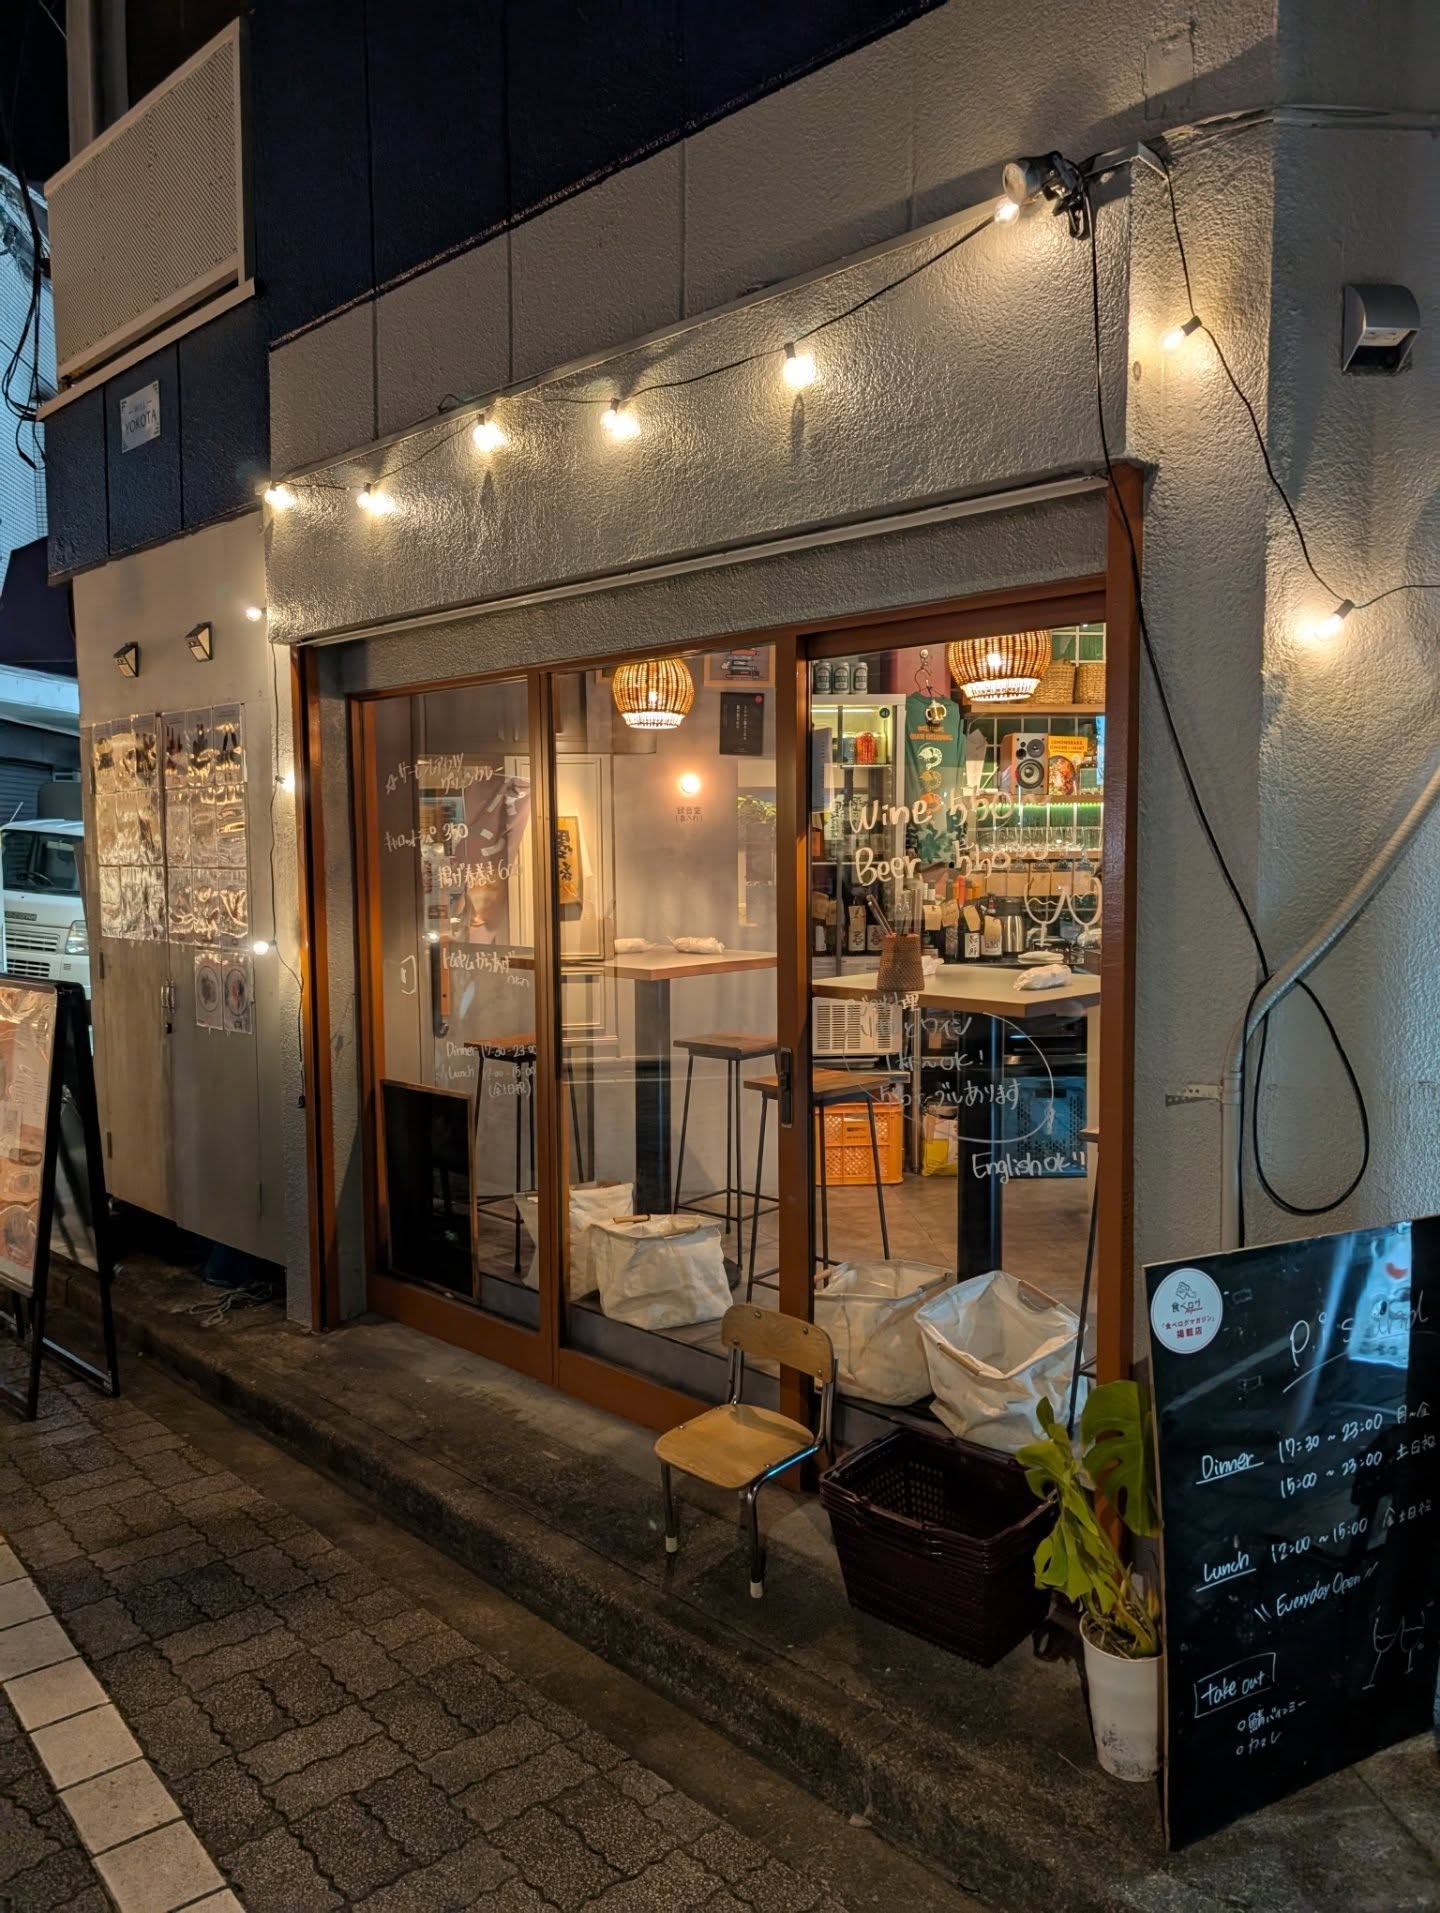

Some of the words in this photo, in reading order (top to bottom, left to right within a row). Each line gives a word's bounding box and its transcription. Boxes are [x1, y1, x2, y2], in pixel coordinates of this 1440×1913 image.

[125, 408, 158, 435] YOKOTA
[850, 799, 933, 834] Wine
[855, 847, 922, 887] Beer
[446, 1041, 478, 1057] Dinner
[448, 1064, 474, 1080] Lunch
[971, 1152, 1042, 1184] English
[1171, 1298, 1202, 1313] 食べログ
[1176, 1326, 1203, 1339] 掲載店
[1201, 1452, 1254, 1480] Dinner
[1278, 1435, 1320, 1463] 17:30
[1341, 1413, 1383, 1442] 23:00
[1280, 1471, 1317, 1499] 15:00
[1341, 1451, 1383, 1476] 23:00
[1203, 1551, 1250, 1583] Lunch
[1271, 1535, 1311, 1563] 12:00
[1332, 1516, 1368, 1543] 15:00
[1276, 1579, 1331, 1618] Everyday
[1331, 1571, 1361, 1596] Open
[1241, 1670, 1266, 1695] out
